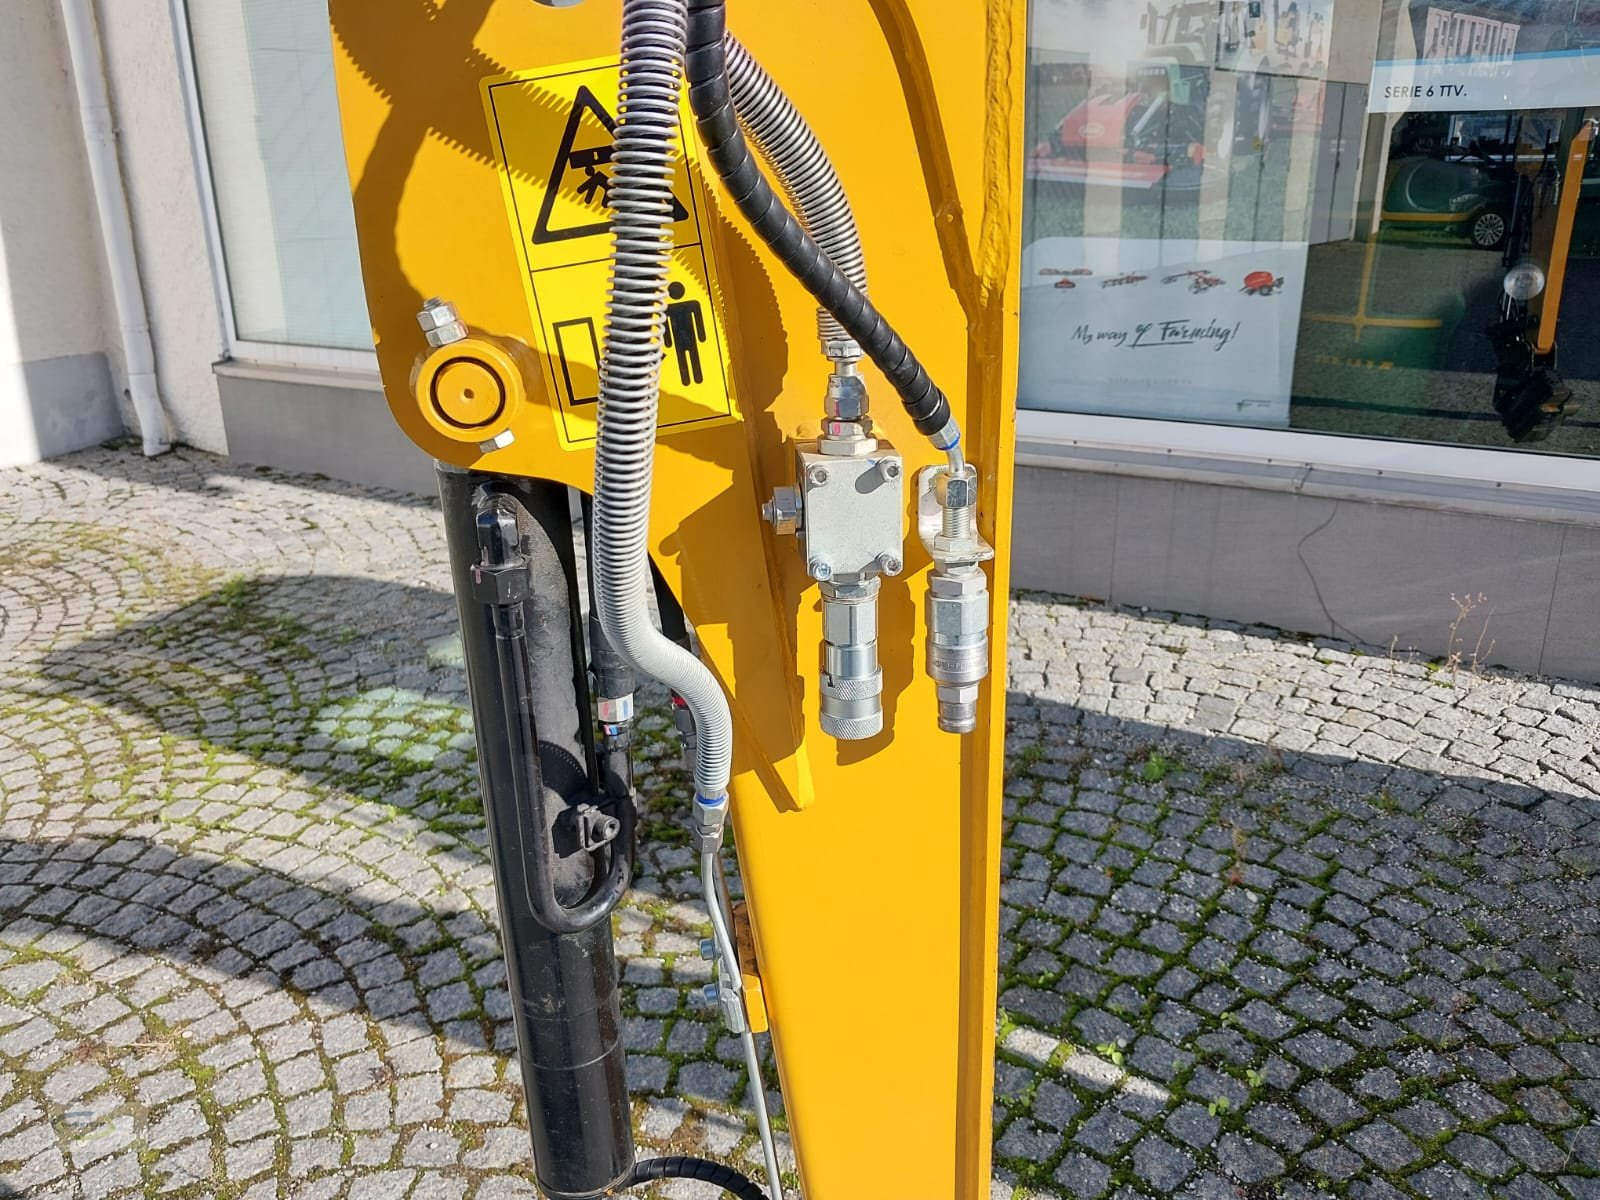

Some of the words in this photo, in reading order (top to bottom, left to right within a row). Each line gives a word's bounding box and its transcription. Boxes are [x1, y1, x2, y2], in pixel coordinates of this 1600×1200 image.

[1384, 85, 1422, 98] SERIE
[1426, 85, 1434, 97] 6
[1439, 84, 1468, 97] TTV.
[1071, 324, 1093, 345] My
[1096, 330, 1128, 348] way
[1132, 322, 1153, 348] of
[1158, 318, 1241, 352] Farming!
